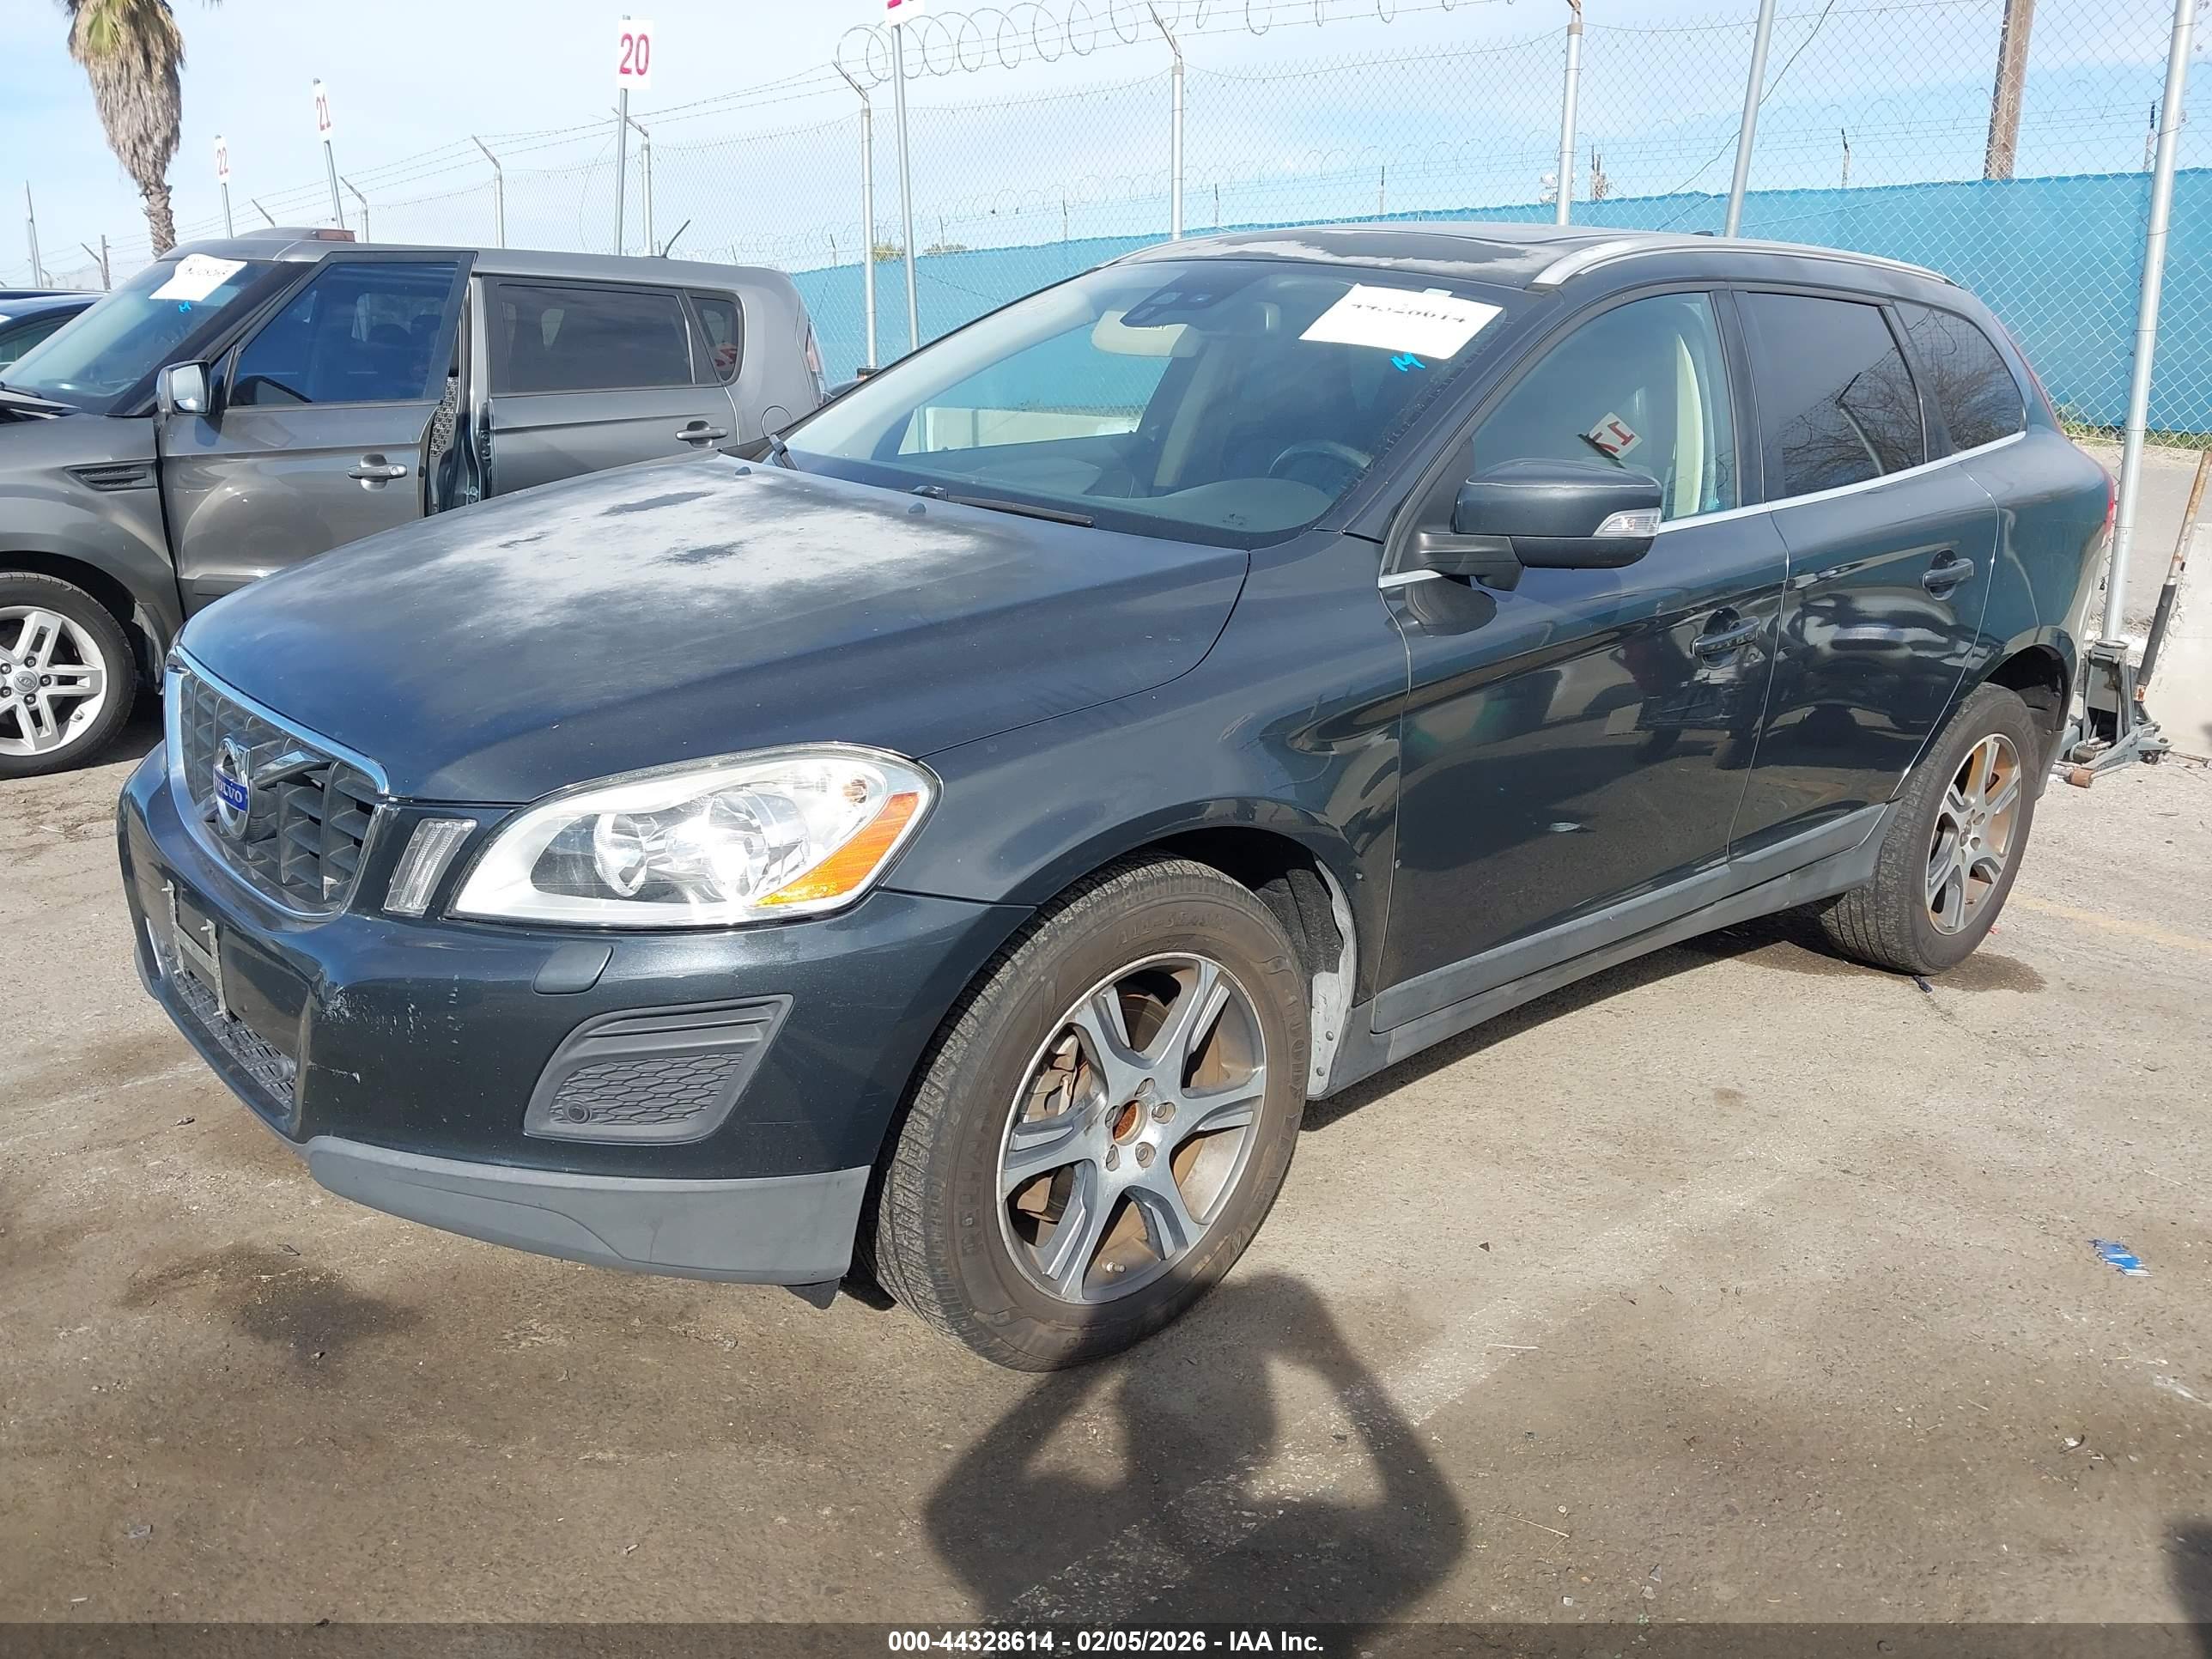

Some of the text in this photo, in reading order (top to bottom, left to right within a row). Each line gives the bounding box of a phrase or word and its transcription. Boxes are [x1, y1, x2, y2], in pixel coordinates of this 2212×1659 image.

[619, 33, 650, 76] 20
[315, 93, 331, 131] 21
[216, 146, 228, 175] 22
